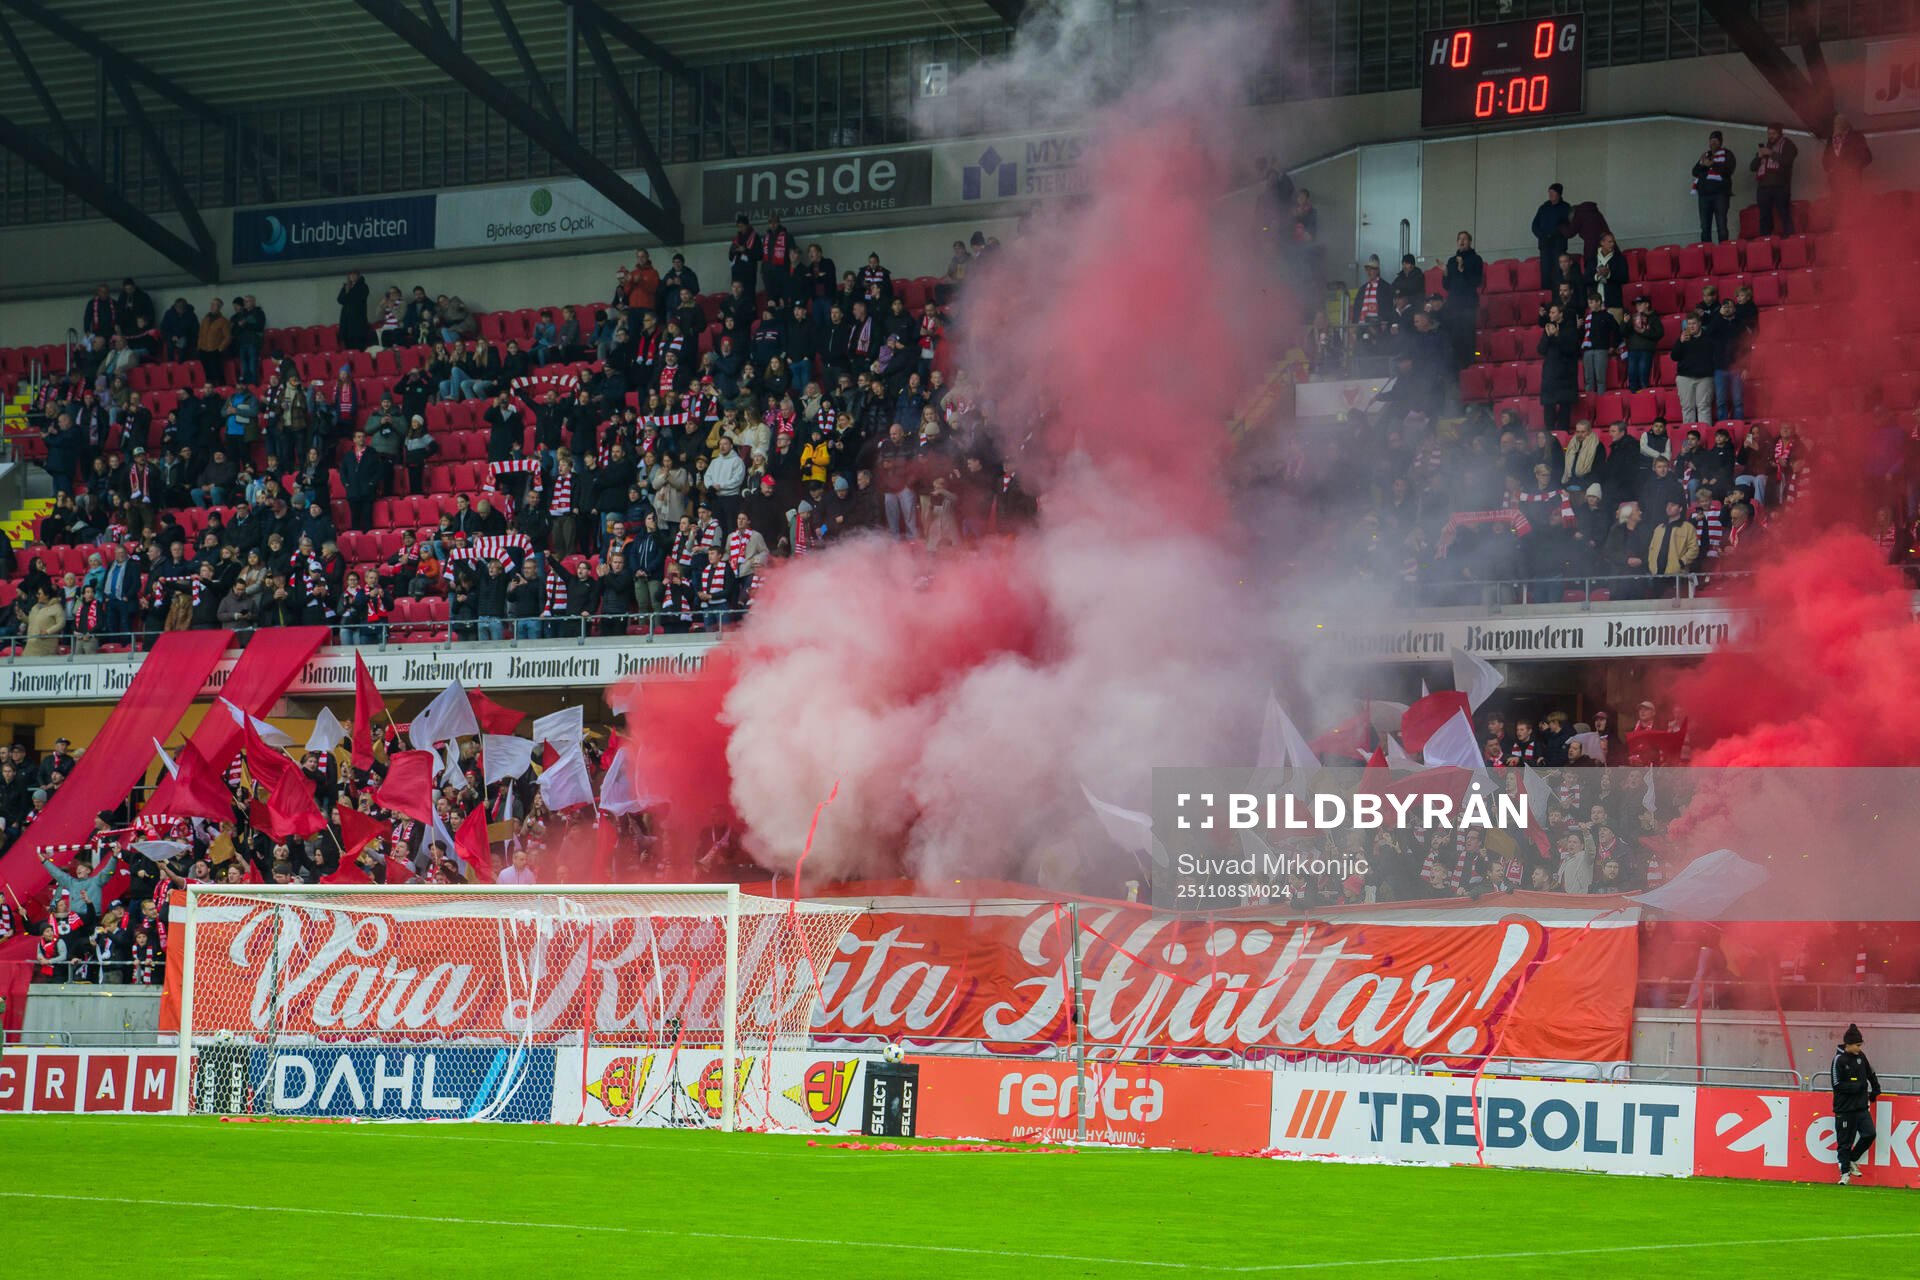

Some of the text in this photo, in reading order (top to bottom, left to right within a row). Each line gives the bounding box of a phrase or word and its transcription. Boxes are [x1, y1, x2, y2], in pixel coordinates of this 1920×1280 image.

[1430, 39, 1448, 65] H
[1451, 32, 1471, 68] 0
[1534, 22, 1554, 58] 0
[1558, 24, 1576, 51] G
[1475, 75, 1549, 117] 0:00
[736, 157, 897, 203] inside
[795, 203, 831, 216] MENS
[836, 198, 896, 212] CLOTHES
[291, 217, 407, 245] Lindbytvätten
[487, 216, 594, 240] Björkegrens Optik
[1463, 625, 1584, 651] Barometern
[1604, 621, 1729, 648] Barometern
[300, 662, 388, 685] Baromrn
[402, 658, 493, 682] Barometern
[507, 655, 600, 680] Barometern
[10, 670, 92, 695] Barometern
[229, 905, 485, 1031] Våra
[983, 904, 1530, 1061] Hjältar!
[275, 1053, 462, 1110] DAHL
[871, 1079, 887, 1135] SELECT
[901, 1080, 912, 1136] SELECT
[998, 1072, 1164, 1122] renta
[1012, 1126, 1145, 1144] MASKINUHYRNING
[1359, 1091, 1680, 1156] TREBOLIT
